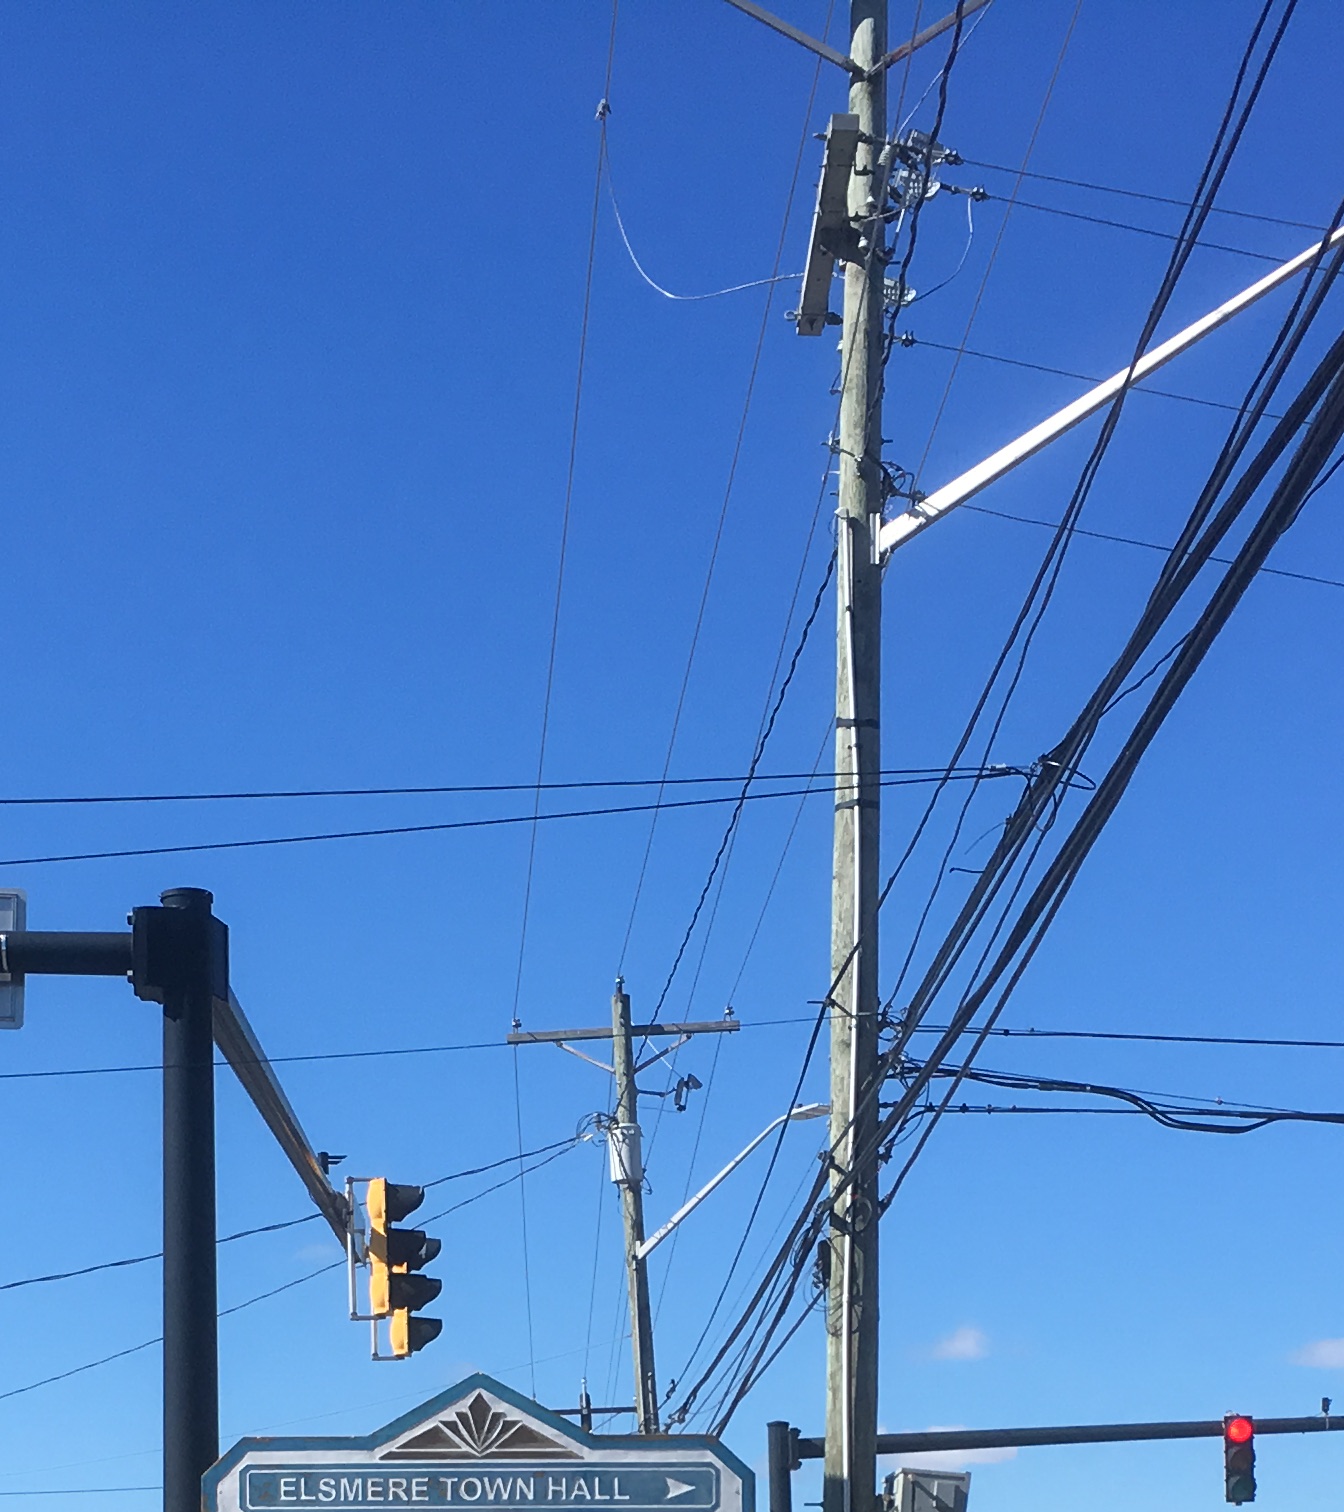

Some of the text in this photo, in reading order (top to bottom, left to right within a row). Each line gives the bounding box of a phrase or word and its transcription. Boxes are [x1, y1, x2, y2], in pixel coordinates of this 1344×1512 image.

[279, 1476, 631, 1502] ELSMERE TOWN HALL
